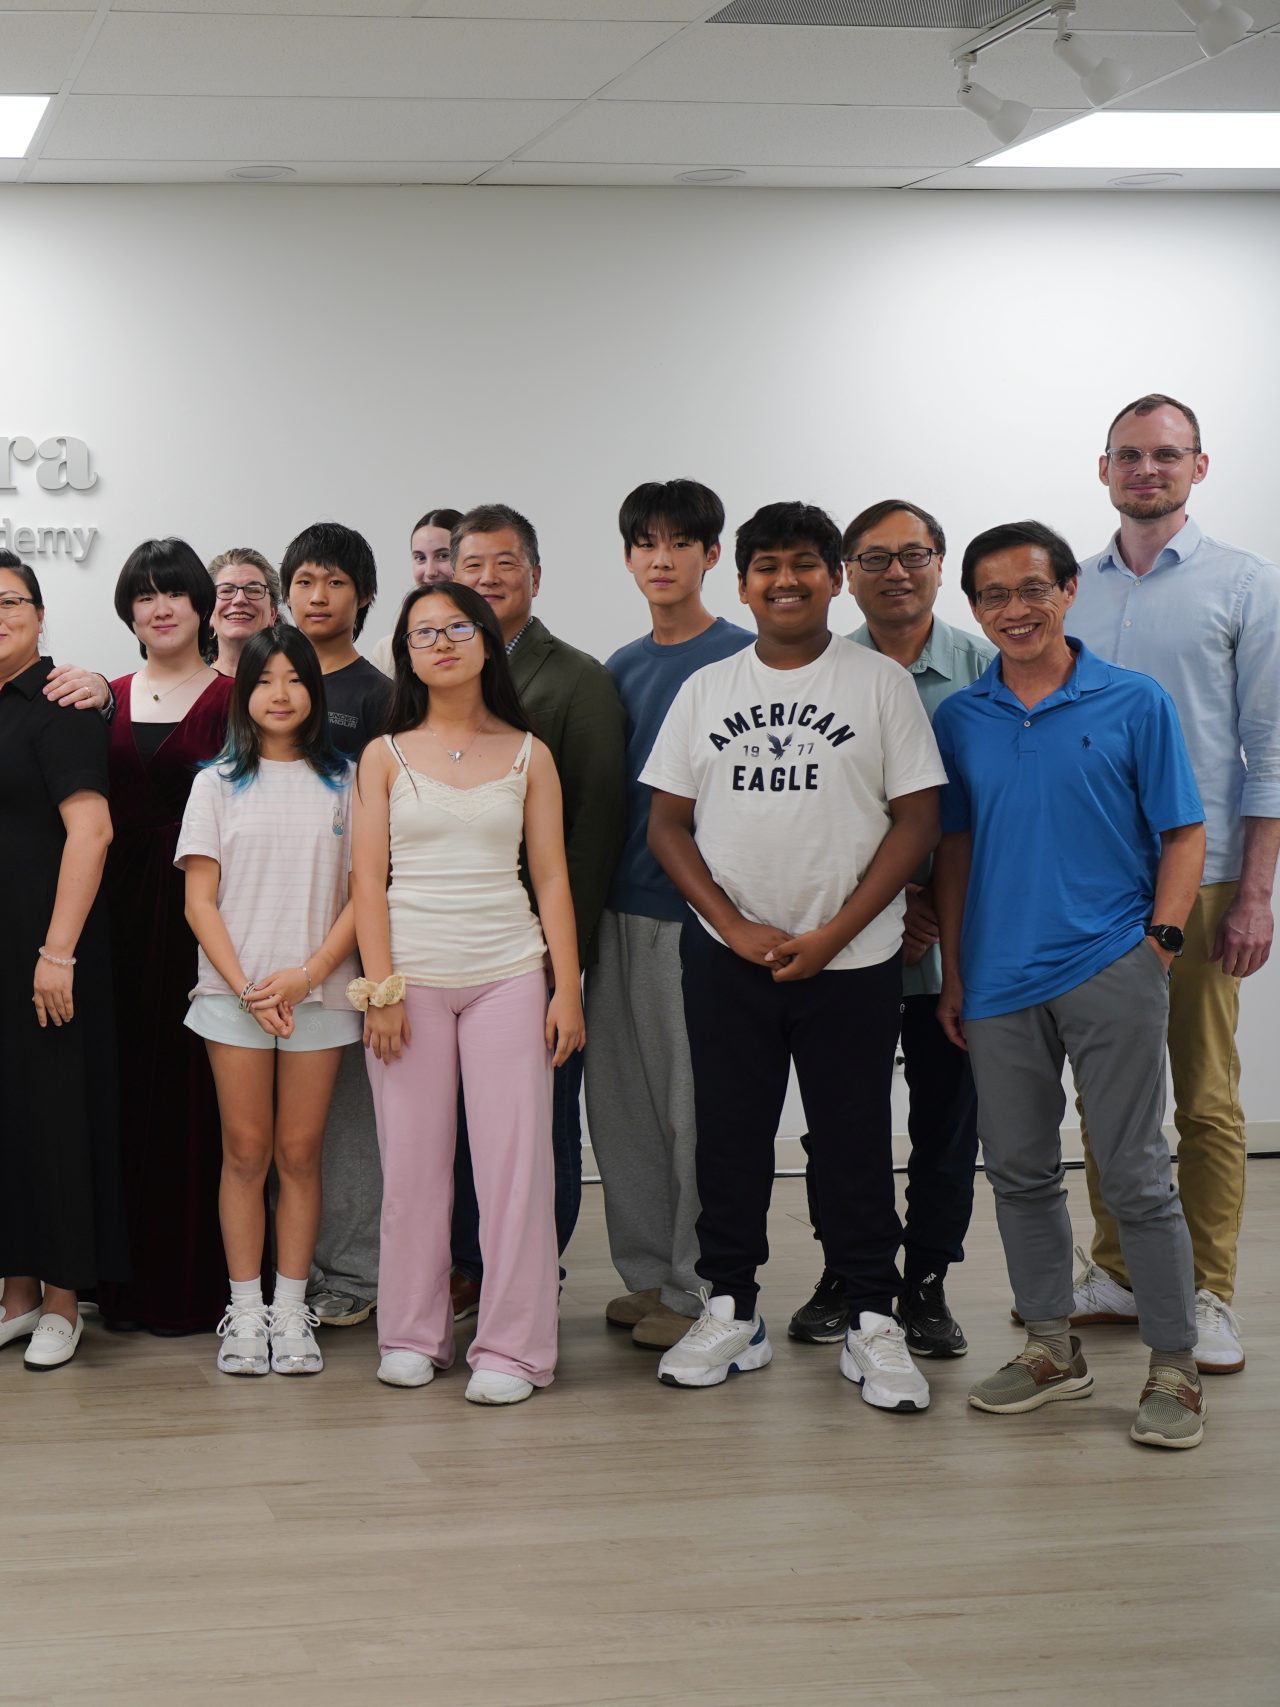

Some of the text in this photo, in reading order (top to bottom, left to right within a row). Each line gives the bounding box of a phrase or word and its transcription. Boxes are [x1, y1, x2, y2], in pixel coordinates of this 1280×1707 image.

[709, 702, 856, 752] AMERICAN
[743, 743, 815, 757] 19 77
[732, 764, 819, 792] EAGLE
